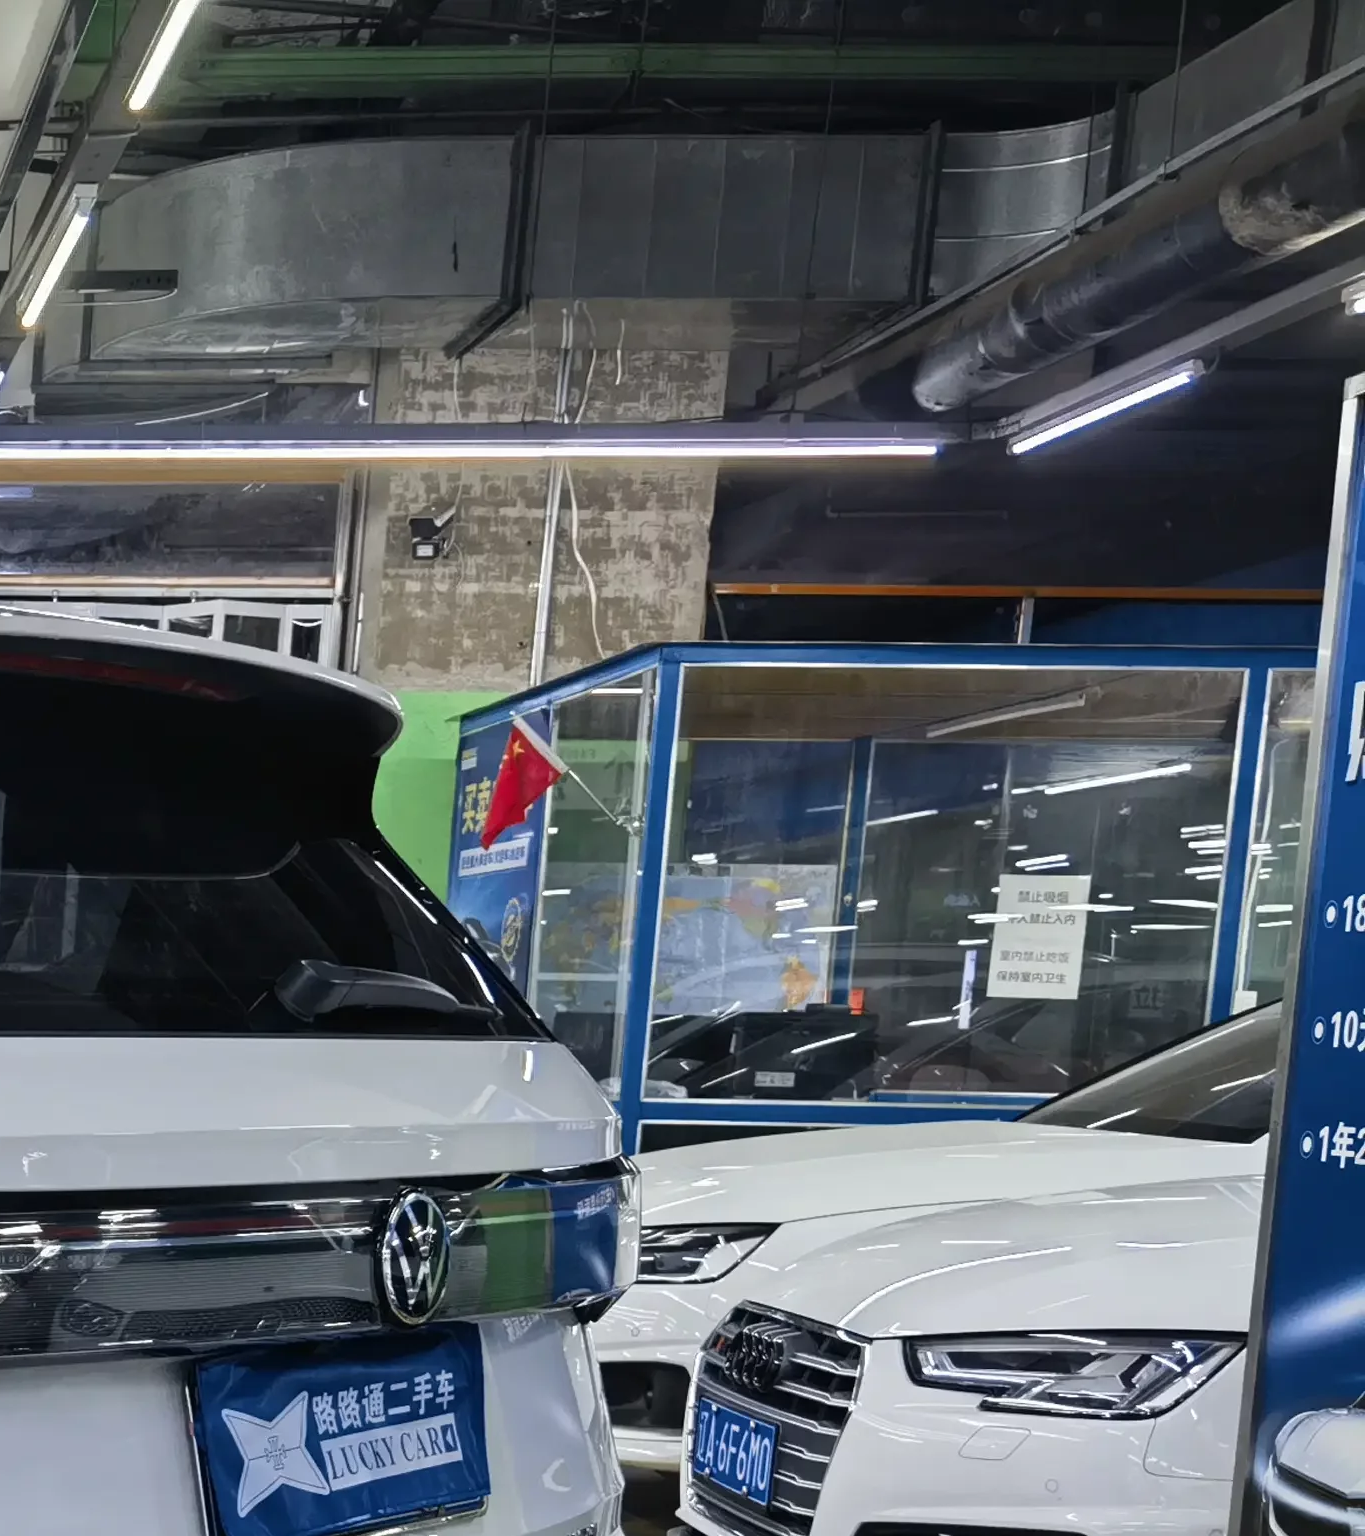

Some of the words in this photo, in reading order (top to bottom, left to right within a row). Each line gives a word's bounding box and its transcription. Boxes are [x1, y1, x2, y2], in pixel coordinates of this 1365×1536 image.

[1017, 890, 1070, 904] 禁止吸烟
[996, 970, 1068, 984] 保持室内卫生
[311, 1368, 456, 1436] 路路通二手车
[325, 1434, 394, 1481] LUCKY
[399, 1426, 443, 1462] CAR
